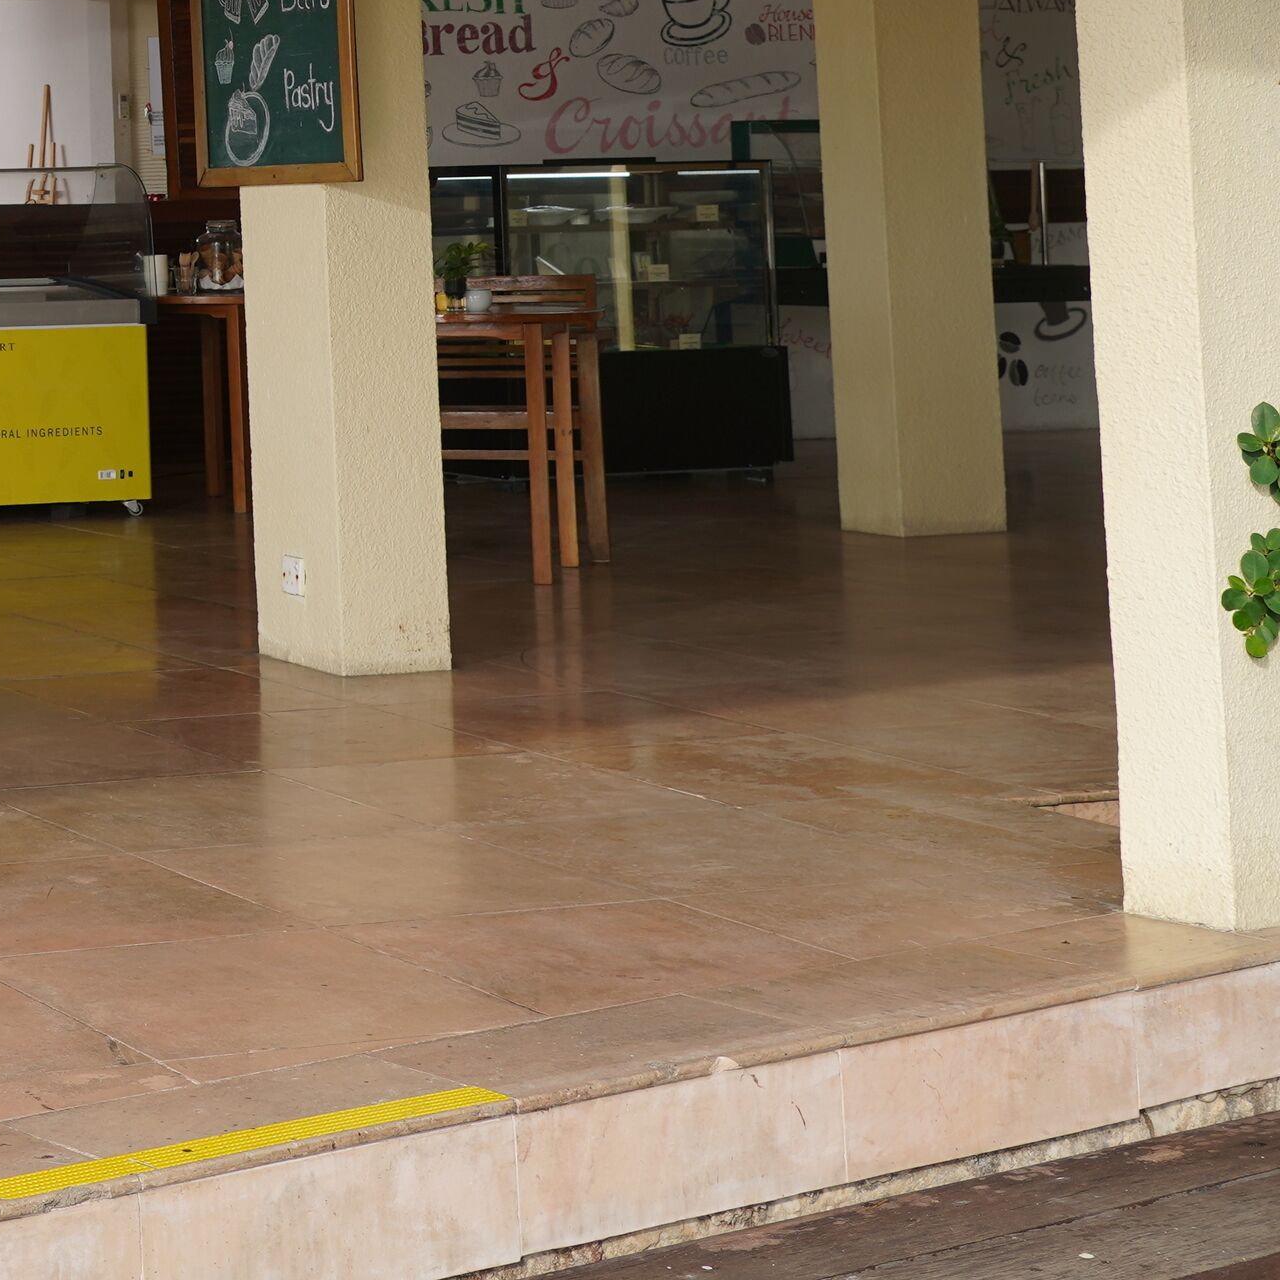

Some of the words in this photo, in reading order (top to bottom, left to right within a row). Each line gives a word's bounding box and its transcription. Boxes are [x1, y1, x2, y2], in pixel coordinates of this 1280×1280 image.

[758, 4, 813, 23] House
[283, 63, 336, 131] Pastry
[26, 425, 104, 439] INGREDIENTS
